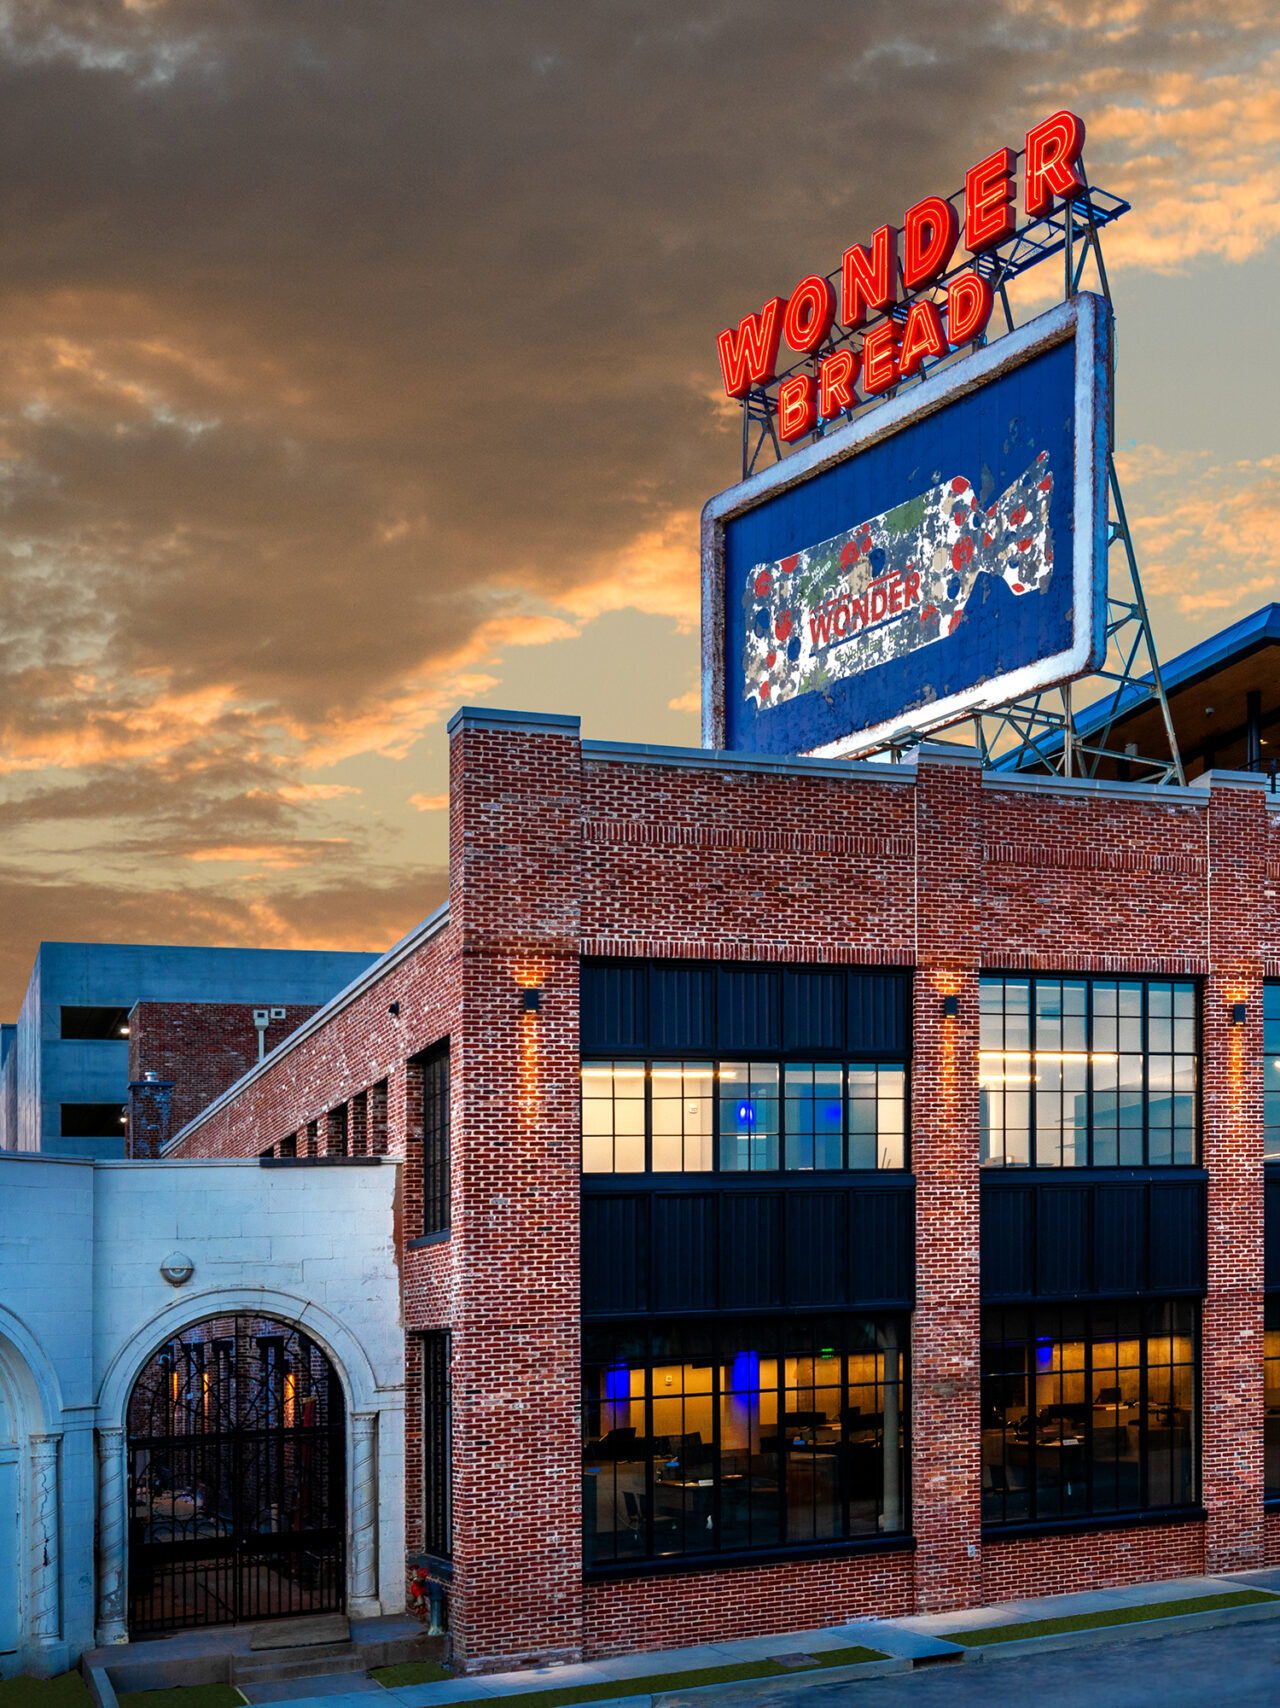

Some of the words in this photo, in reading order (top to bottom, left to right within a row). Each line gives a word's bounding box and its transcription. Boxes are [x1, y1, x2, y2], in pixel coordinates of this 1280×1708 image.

[717, 110, 1086, 398] WONDER
[778, 272, 994, 444] BREAD
[809, 571, 921, 644] WONDER
